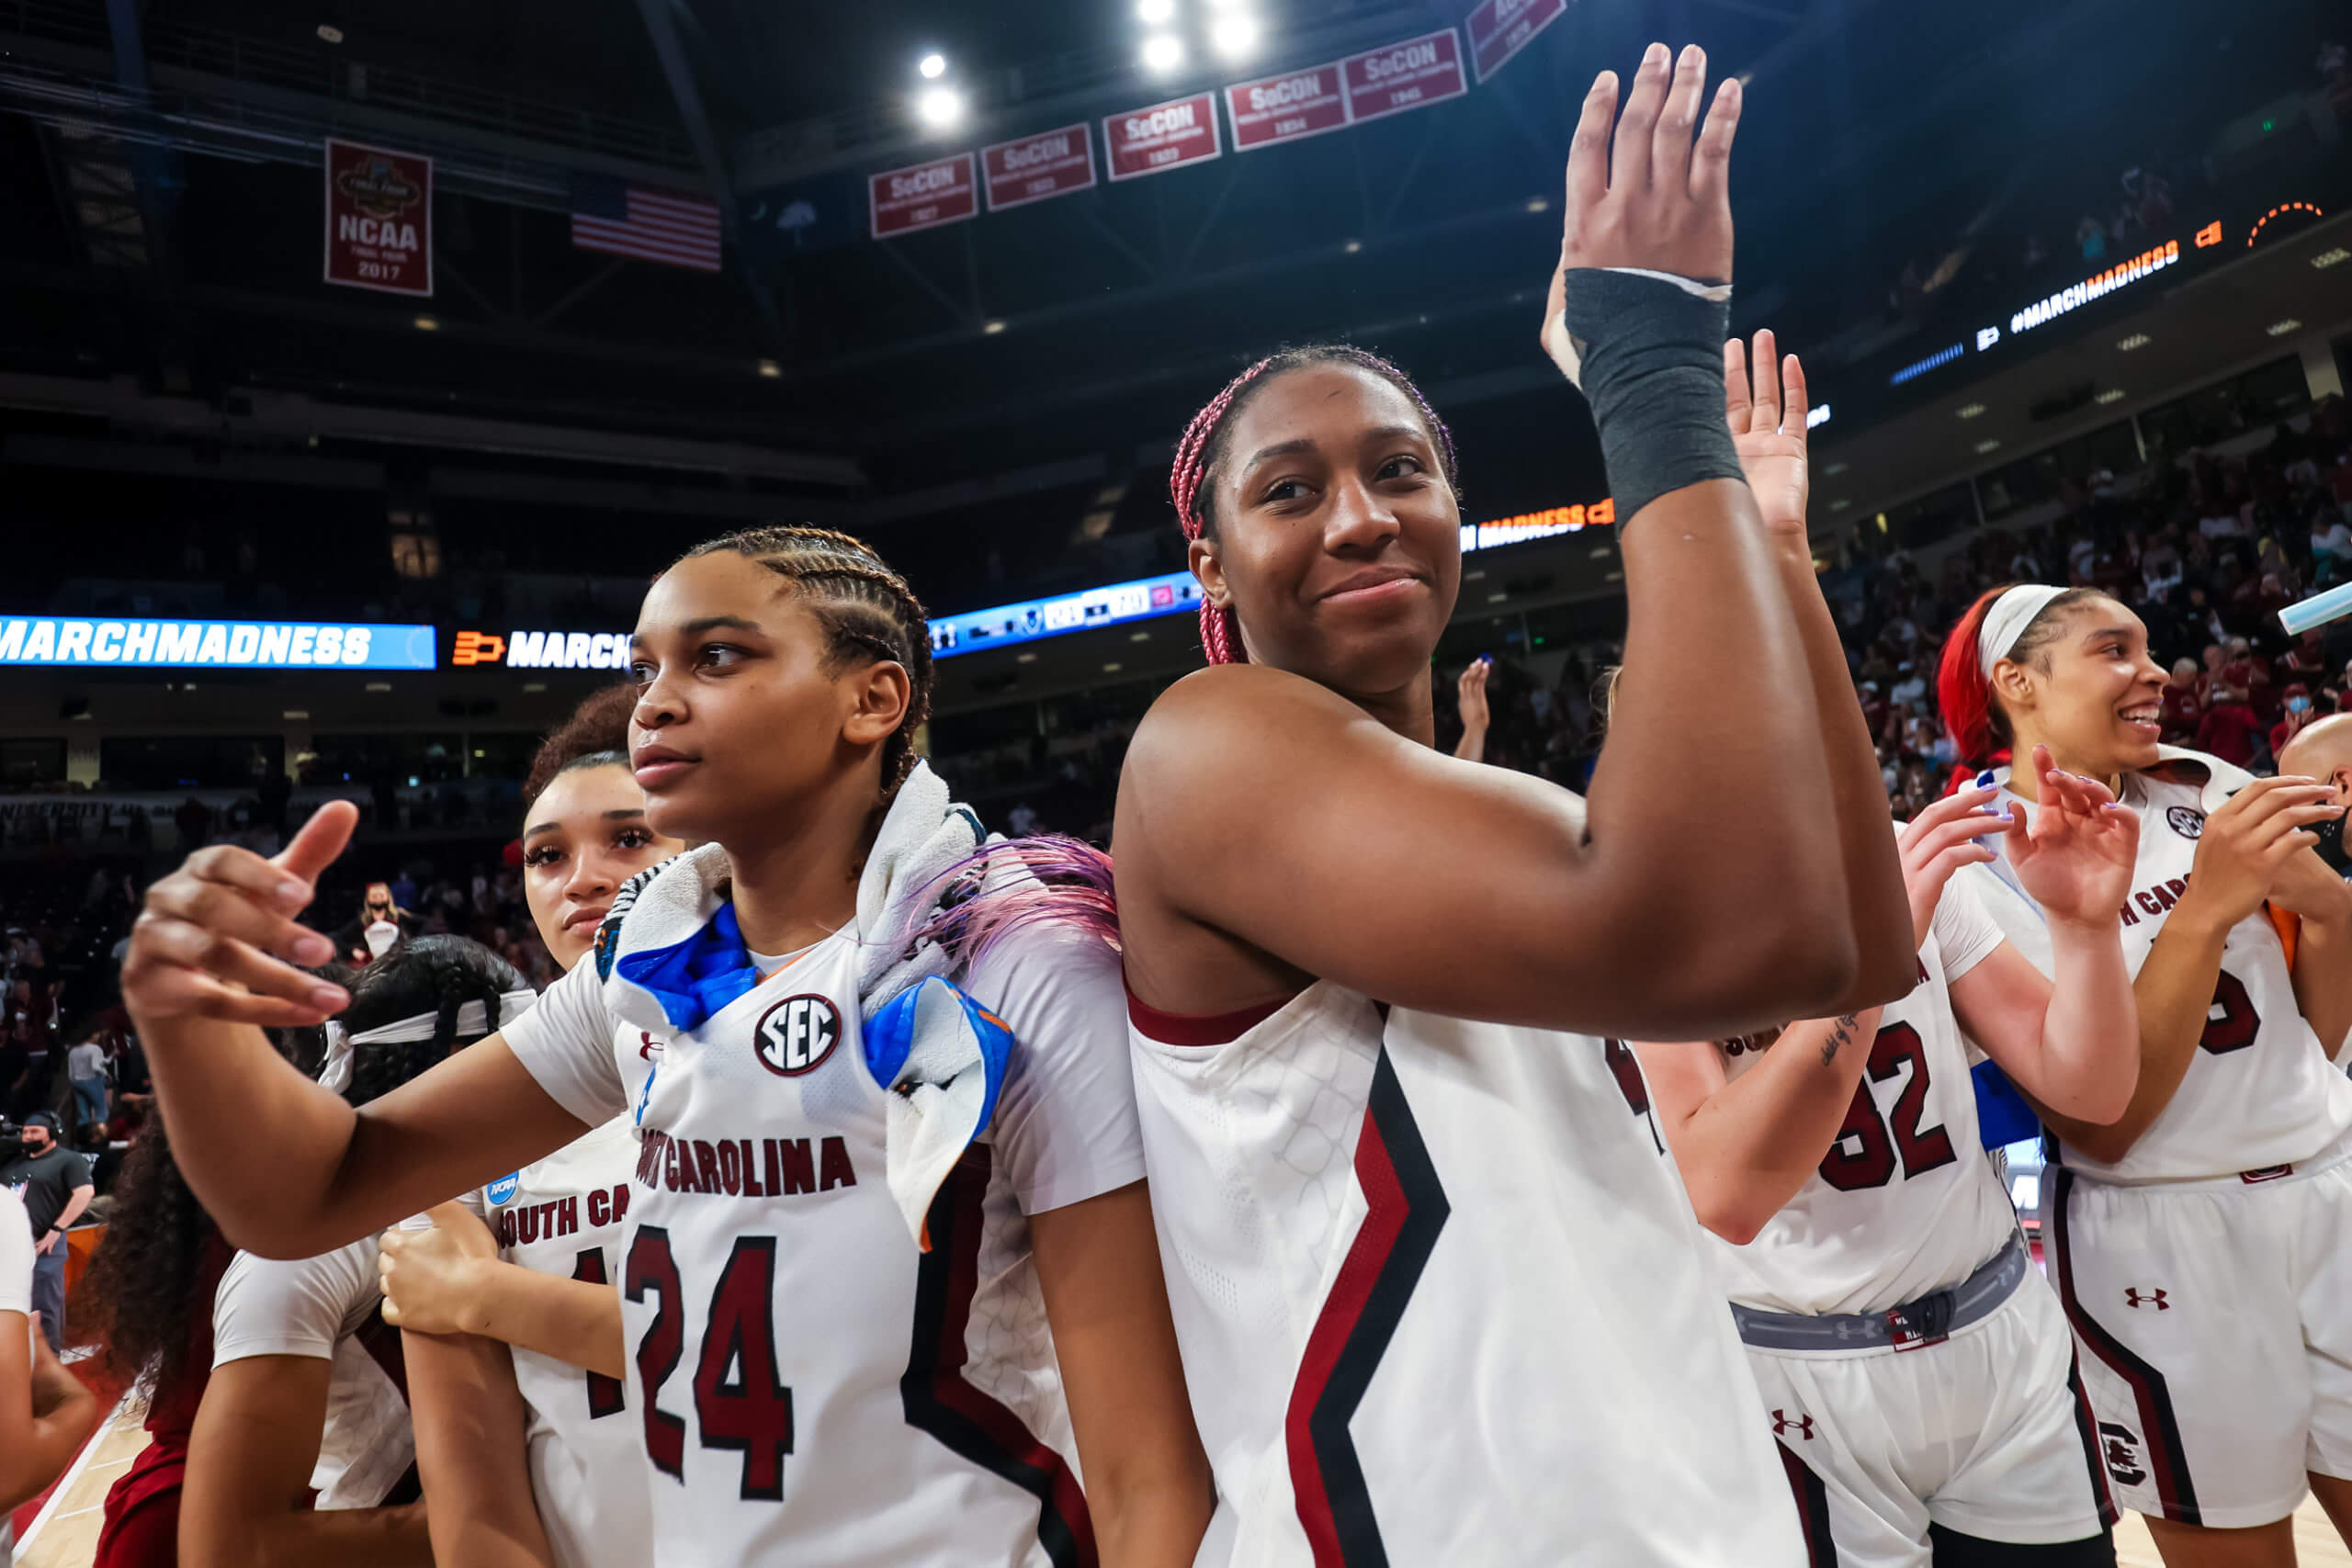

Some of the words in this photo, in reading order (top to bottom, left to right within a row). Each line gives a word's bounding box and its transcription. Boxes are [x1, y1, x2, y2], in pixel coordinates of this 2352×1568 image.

[1364, 41, 1437, 81] SoCON
[1250, 73, 1320, 110] SoCON
[1125, 104, 1194, 140] SoCON
[1003, 135, 1069, 170] SoCON
[889, 166, 955, 198] SoCON
[339, 214, 418, 252] NCAA
[358, 261, 401, 280] 2017
[2010, 239, 2179, 334] #MARCHMADNESS
[761, 999, 832, 1070] SEC
[664, 1135, 857, 1197] CAROLINA
[491, 1177, 516, 1196] NCAA
[625, 1224, 794, 1503] 24
